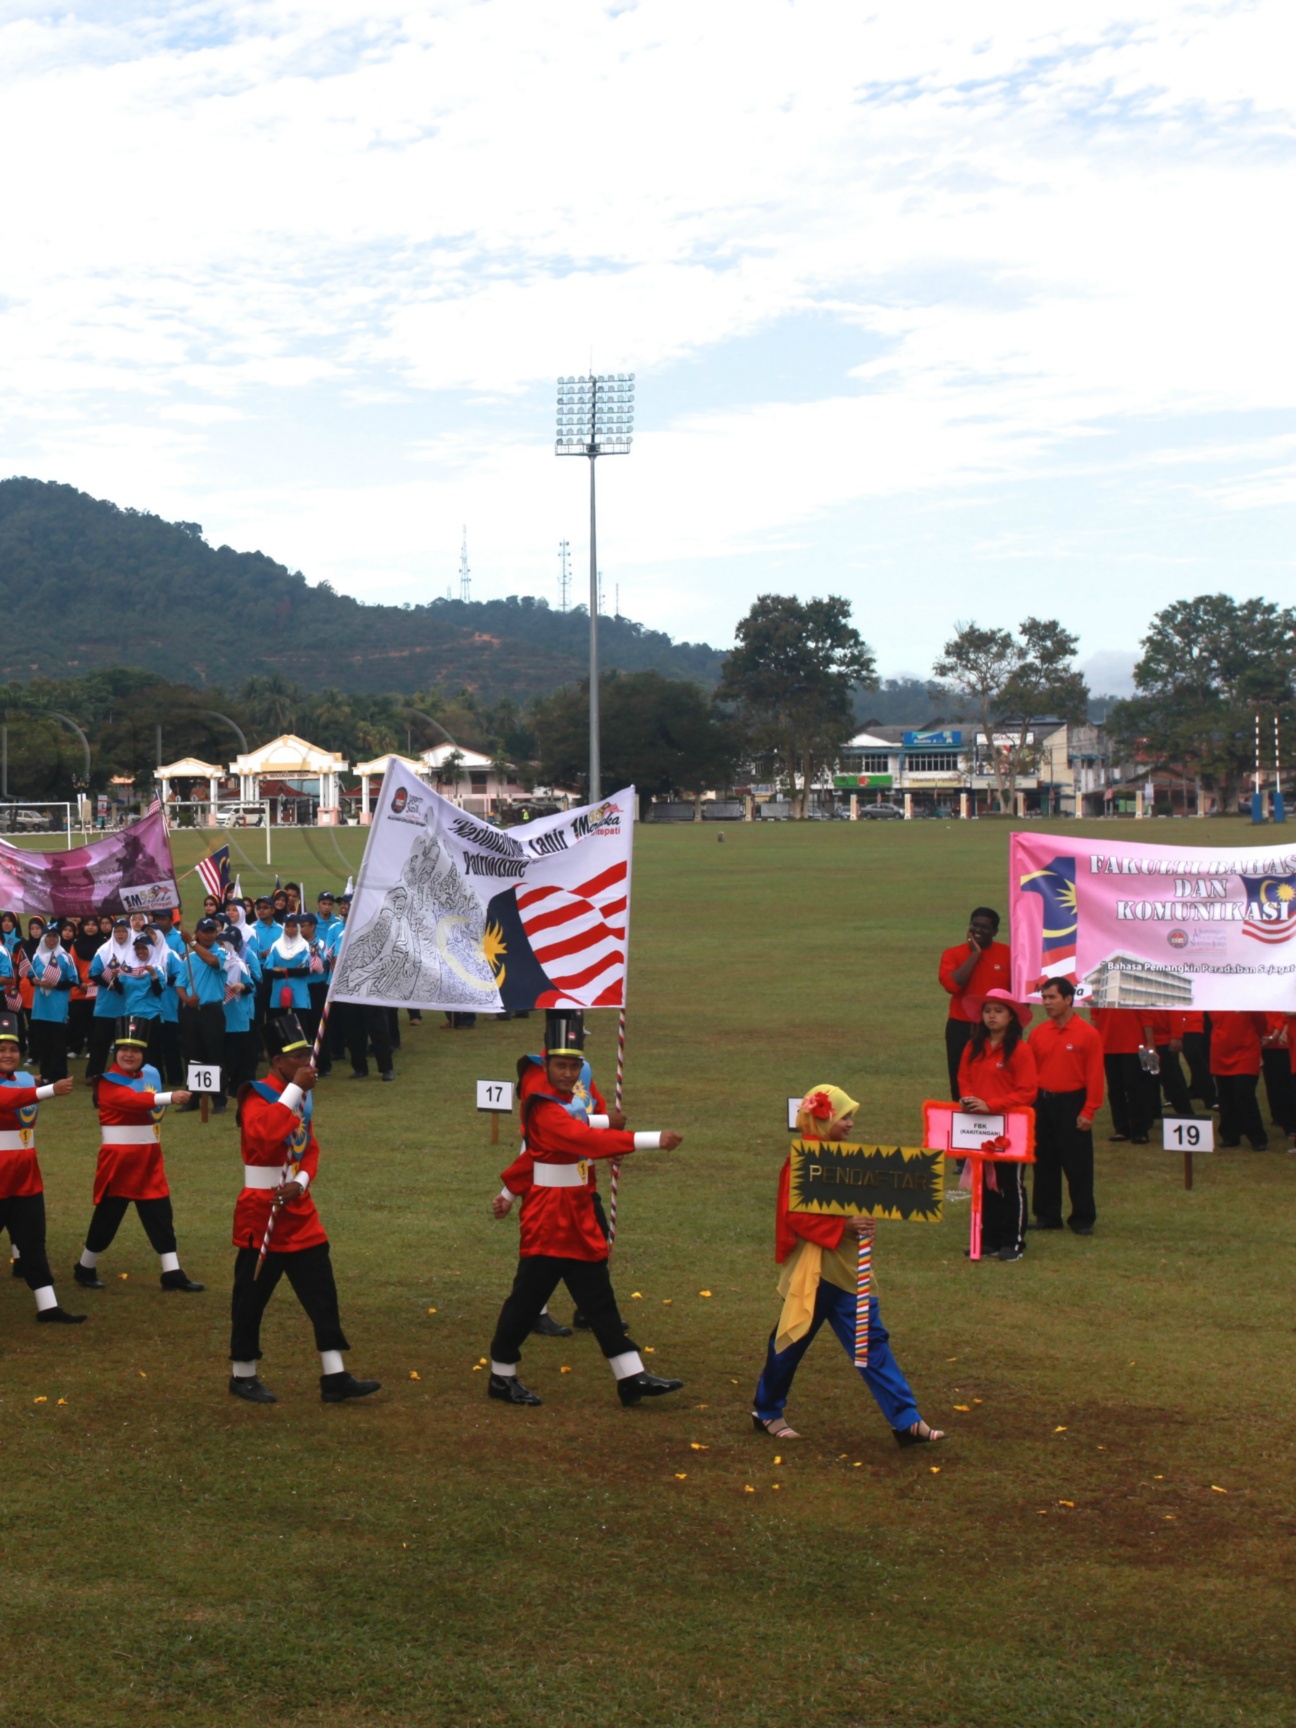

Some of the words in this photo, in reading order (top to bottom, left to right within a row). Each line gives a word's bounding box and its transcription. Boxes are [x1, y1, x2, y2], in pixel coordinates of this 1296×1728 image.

[1089, 854, 1201, 876] FAKULTI
[1173, 878, 1227, 899] DAN
[1116, 901, 1290, 922] KOMUNIKASI
[1144, 962, 1200, 974] Pemangkin
[1202, 963, 1256, 974] Peradaban
[194, 1070, 212, 1088] 16
[486, 1086, 503, 1102] 17
[959, 1129, 1001, 1137] (KAKITANGAN)
[973, 1122, 987, 1130] FBK
[1173, 1124, 1200, 1146] 19
[808, 1163, 927, 1191] PENDAFTAR
